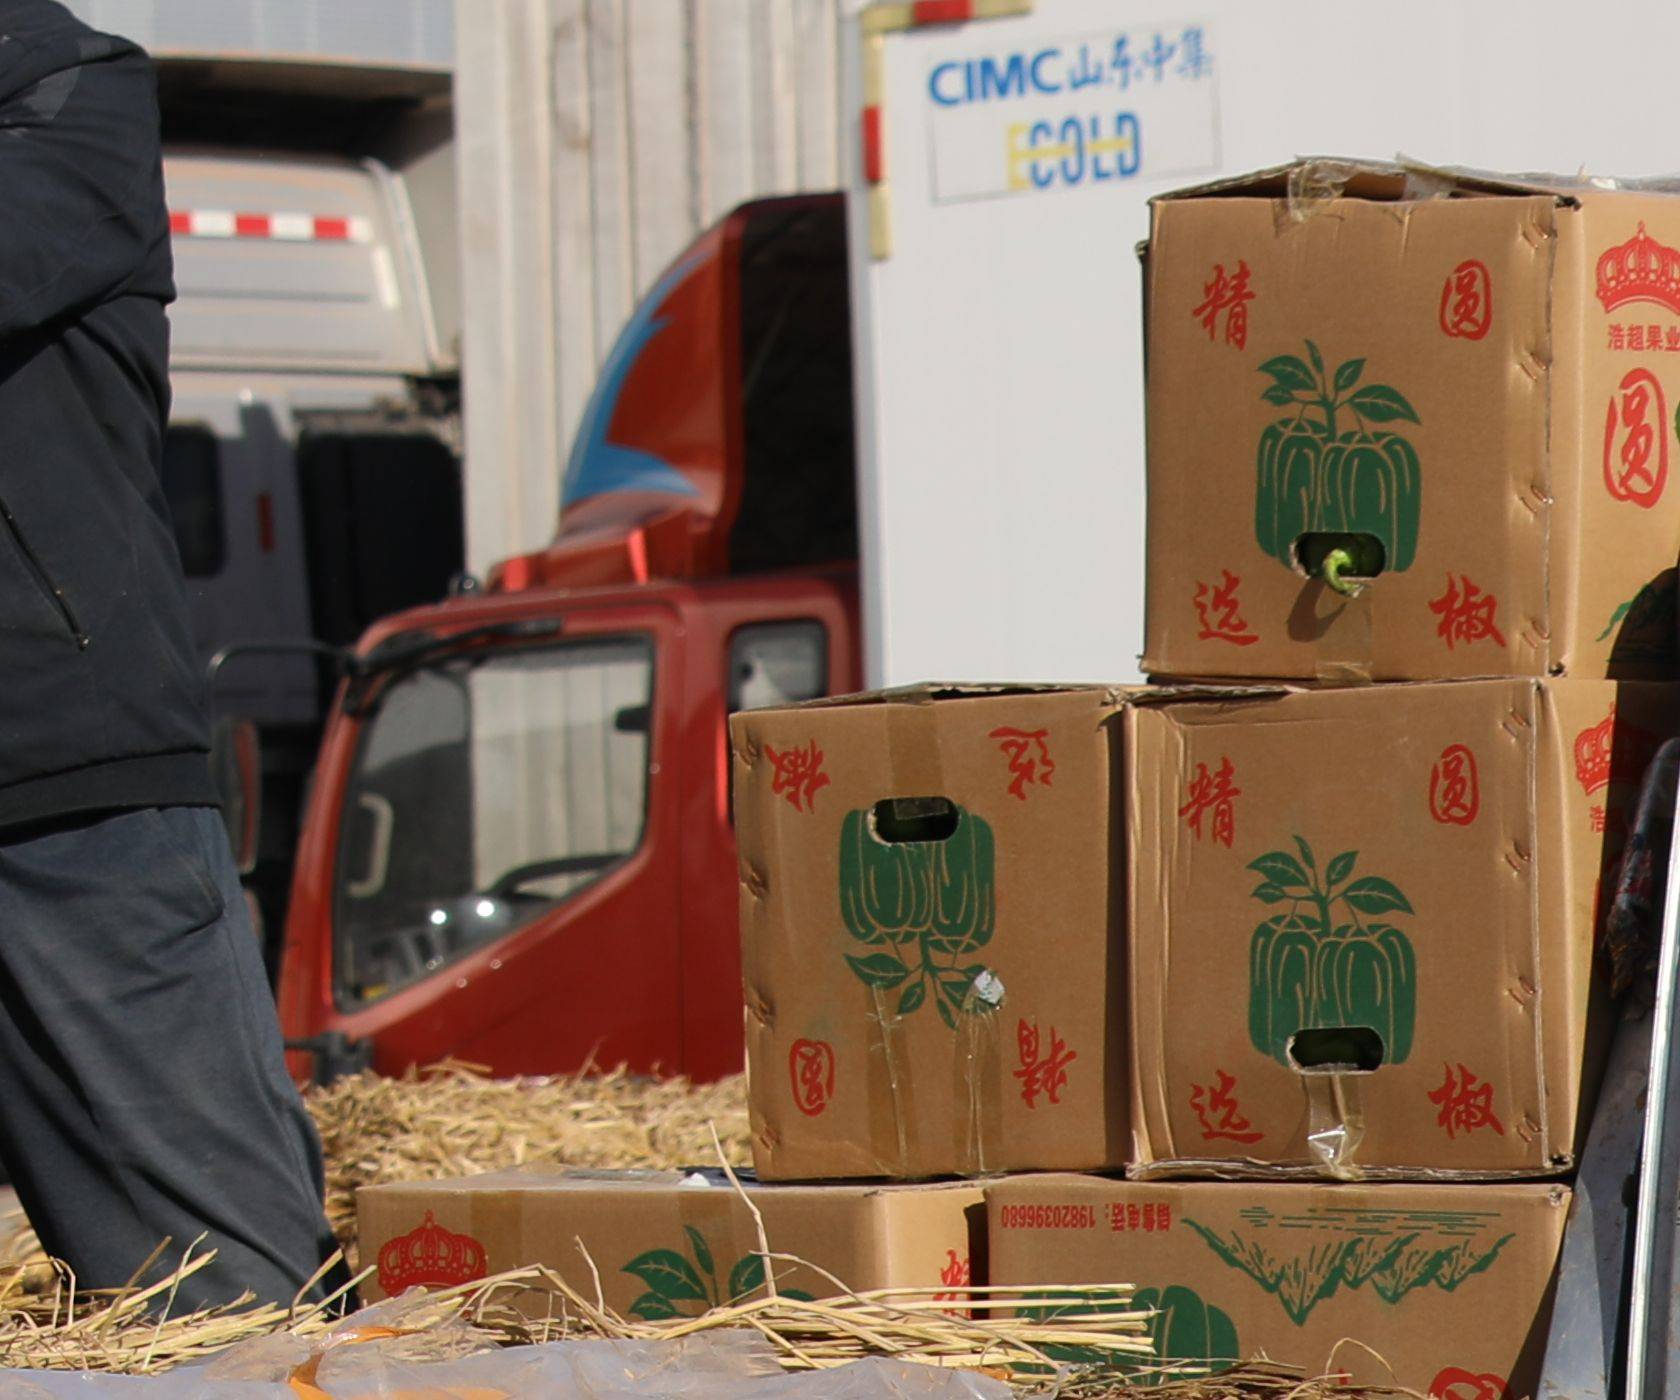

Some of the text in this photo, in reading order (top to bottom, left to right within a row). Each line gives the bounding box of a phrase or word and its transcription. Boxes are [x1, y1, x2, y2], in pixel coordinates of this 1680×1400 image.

[929, 47, 1060, 107] CIMC
[1192, 259, 1257, 352] 精
[1439, 257, 1494, 342] 圆
[1603, 368, 1668, 509] 圆
[1192, 568, 1263, 647] 选
[1427, 571, 1508, 654] 椒
[759, 738, 832, 813] 椒
[988, 726, 1056, 802] 选
[1178, 754, 1244, 849] 精
[1428, 742, 1482, 832] 圆
[785, 1037, 837, 1118] 圆
[1011, 1017, 1079, 1110] 精
[1425, 1062, 1507, 1142] 椒
[1190, 1068, 1268, 1144] 选
